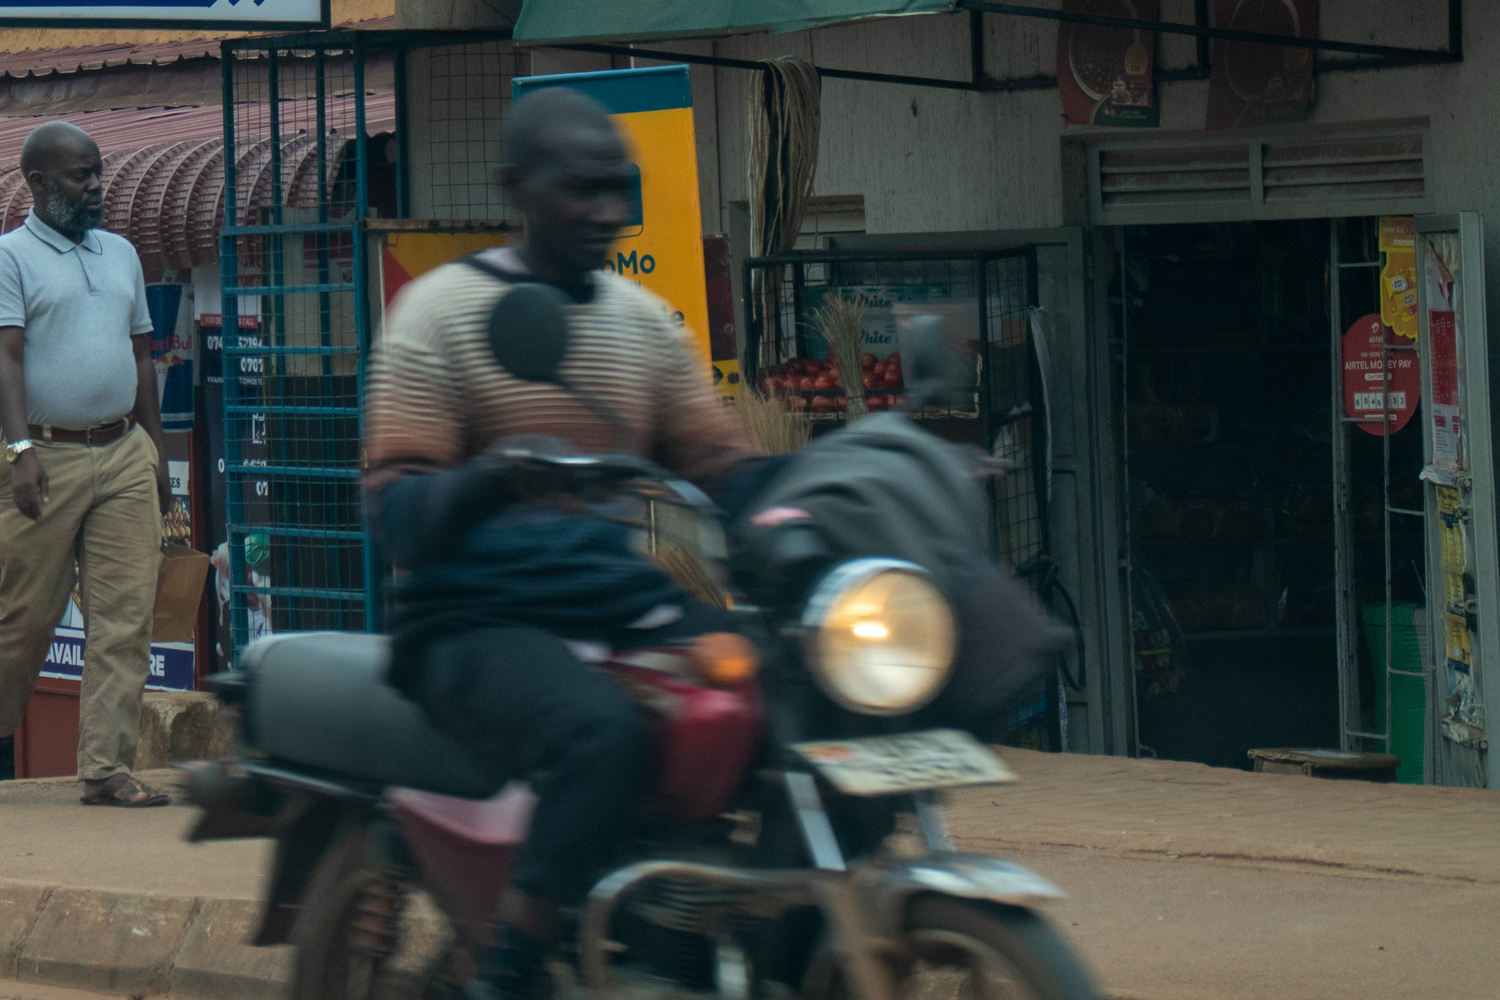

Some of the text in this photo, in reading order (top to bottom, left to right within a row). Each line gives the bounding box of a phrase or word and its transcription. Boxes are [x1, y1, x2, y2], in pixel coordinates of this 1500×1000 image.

[603, 250, 656, 277] oMo
[171, 334, 193, 350] Bul
[1345, 359, 1412, 370] AIRTEL MOEY PAY
[45, 642, 166, 677] AVAIL RE
